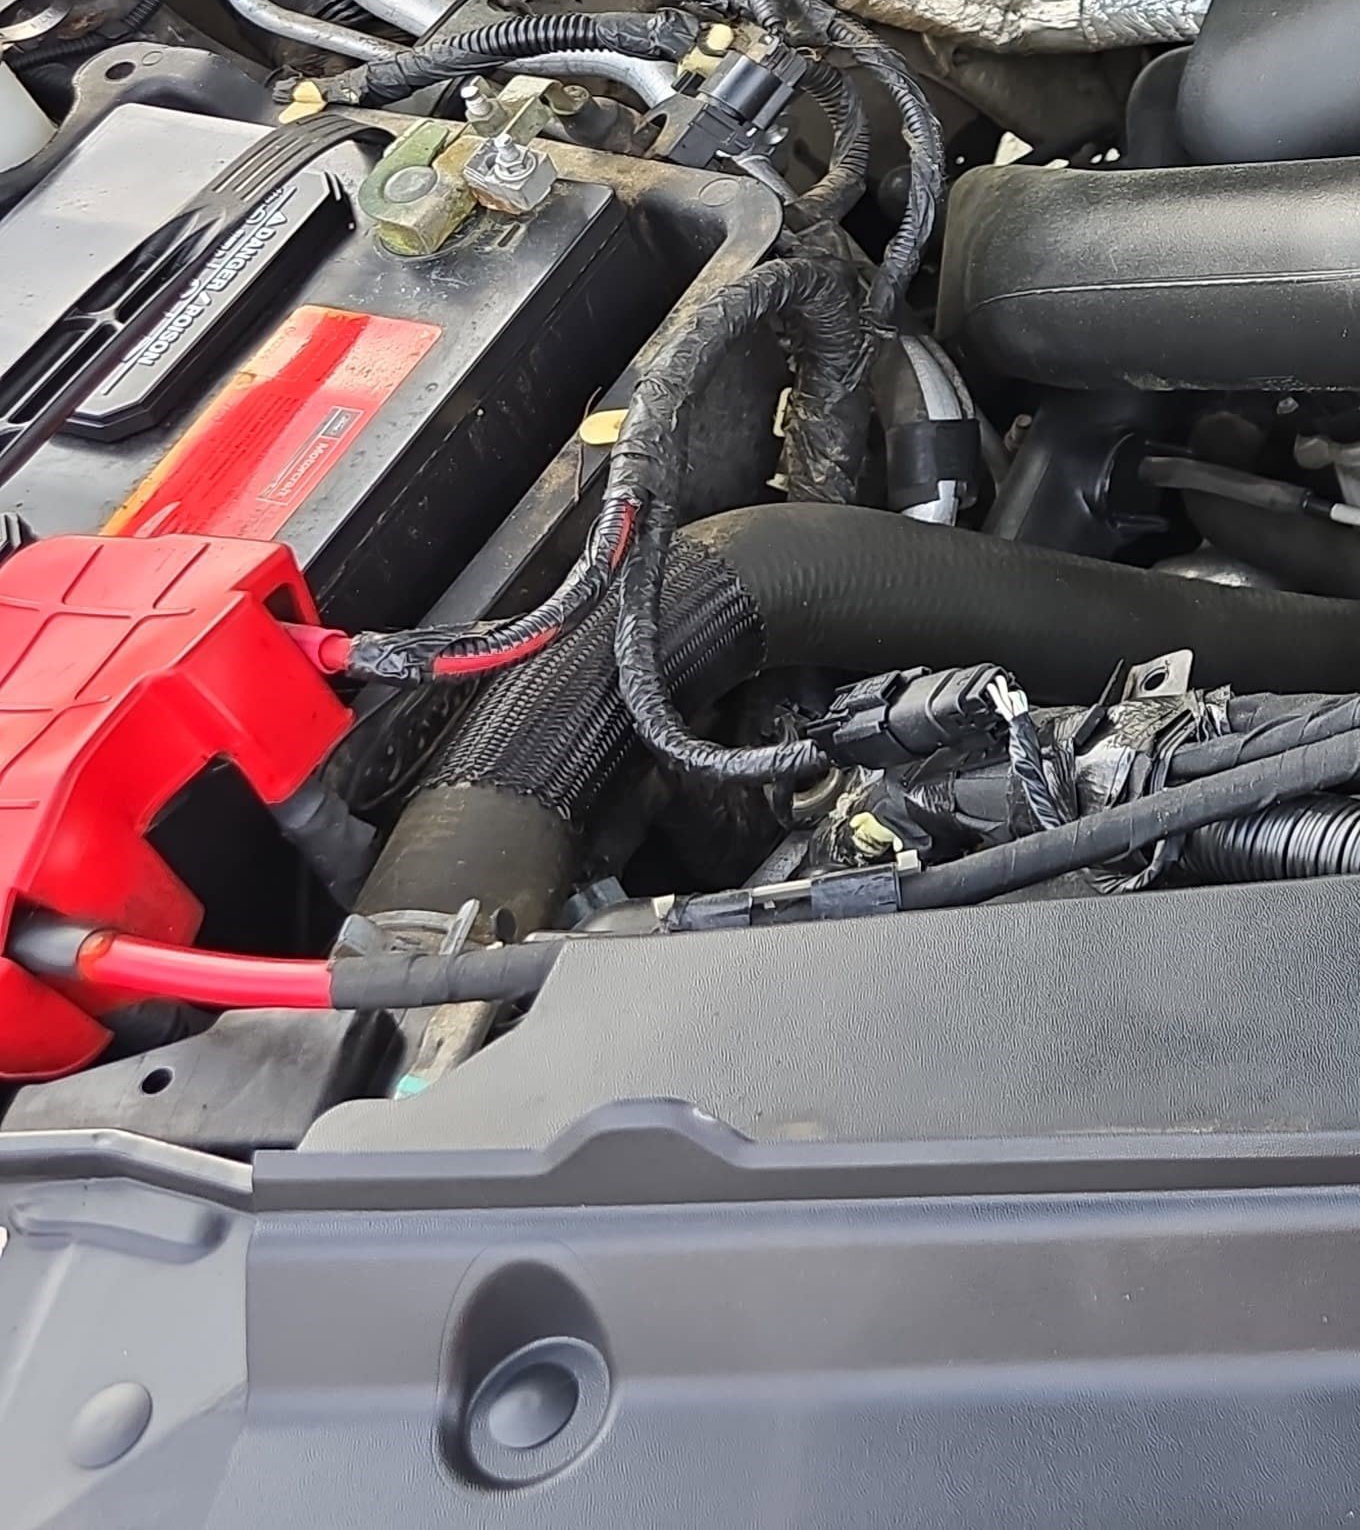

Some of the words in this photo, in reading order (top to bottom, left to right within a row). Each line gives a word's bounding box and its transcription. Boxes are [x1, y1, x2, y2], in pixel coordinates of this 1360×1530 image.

[206, 229, 273, 293] DANGER
[138, 304, 204, 367] POISON
[278, 441, 329, 498] Motorcraft
